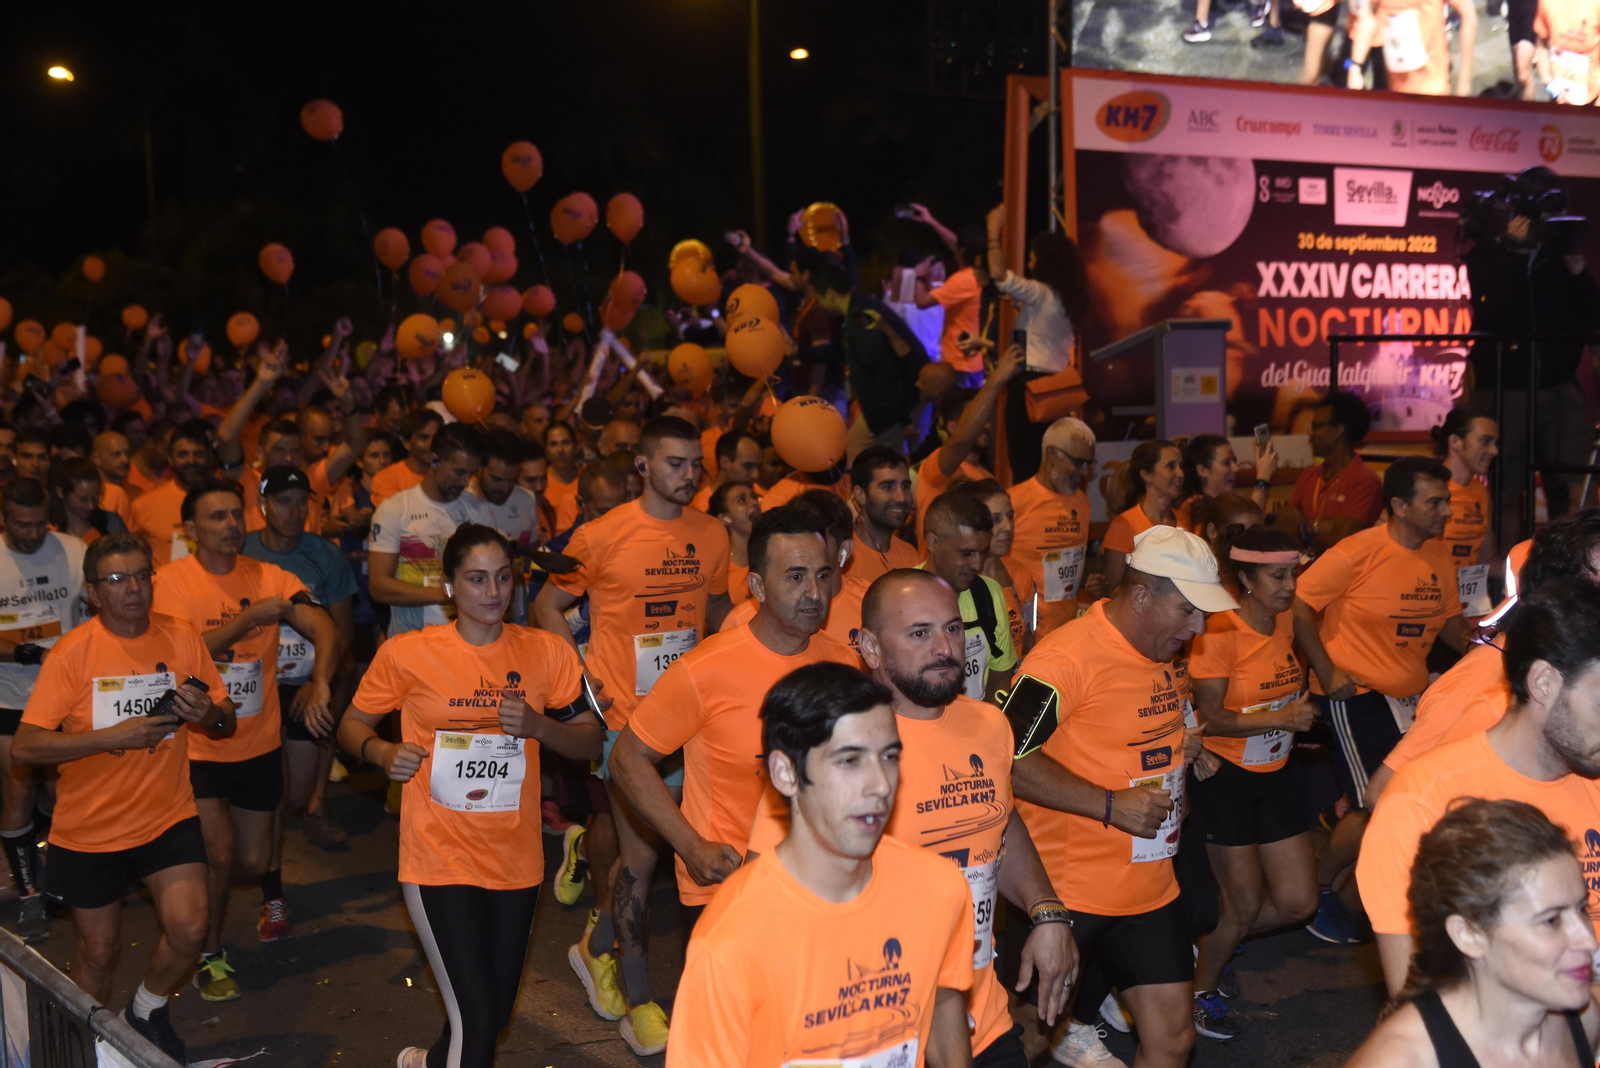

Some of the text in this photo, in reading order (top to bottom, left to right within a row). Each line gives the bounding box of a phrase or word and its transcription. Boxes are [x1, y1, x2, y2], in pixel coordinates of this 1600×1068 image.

[1187, 110, 1220, 127] ABC
[1236, 116, 1302, 138] Cruzcampo
[1312, 123, 1378, 139] TORRE SEVILLA
[1298, 232, 1437, 255] 30 de septiembre 2022
[1256, 261, 1471, 300] XXXIV CARRERA
[1258, 307, 1475, 347] NOCTURNA
[1261, 361, 1290, 388] del
[645, 568, 680, 576] SEVILLA
[662, 559, 701, 567] NOCTURNA
[1058, 564, 1078, 579] 9097
[0, 587, 68, 607] #Sevilla10
[1400, 593, 1429, 601] SEVILLA
[20, 627, 43, 641] 742
[278, 643, 306, 657] 7135
[654, 652, 684, 670] 13
[965, 659, 979, 677] 36
[226, 680, 257, 696] 1240
[1259, 679, 1289, 690] SEVILLA
[113, 697, 161, 717] 1450
[448, 698, 498, 708] SEVILLA
[1138, 703, 1167, 718] SEVILLA
[455, 760, 509, 779] 15204
[940, 778, 995, 795] NOCTURNA
[916, 795, 969, 814] SEVILLA
[973, 898, 992, 925] 59
[838, 972, 911, 1000] NOCTURNA
[804, 998, 871, 1029] SEVILLA
